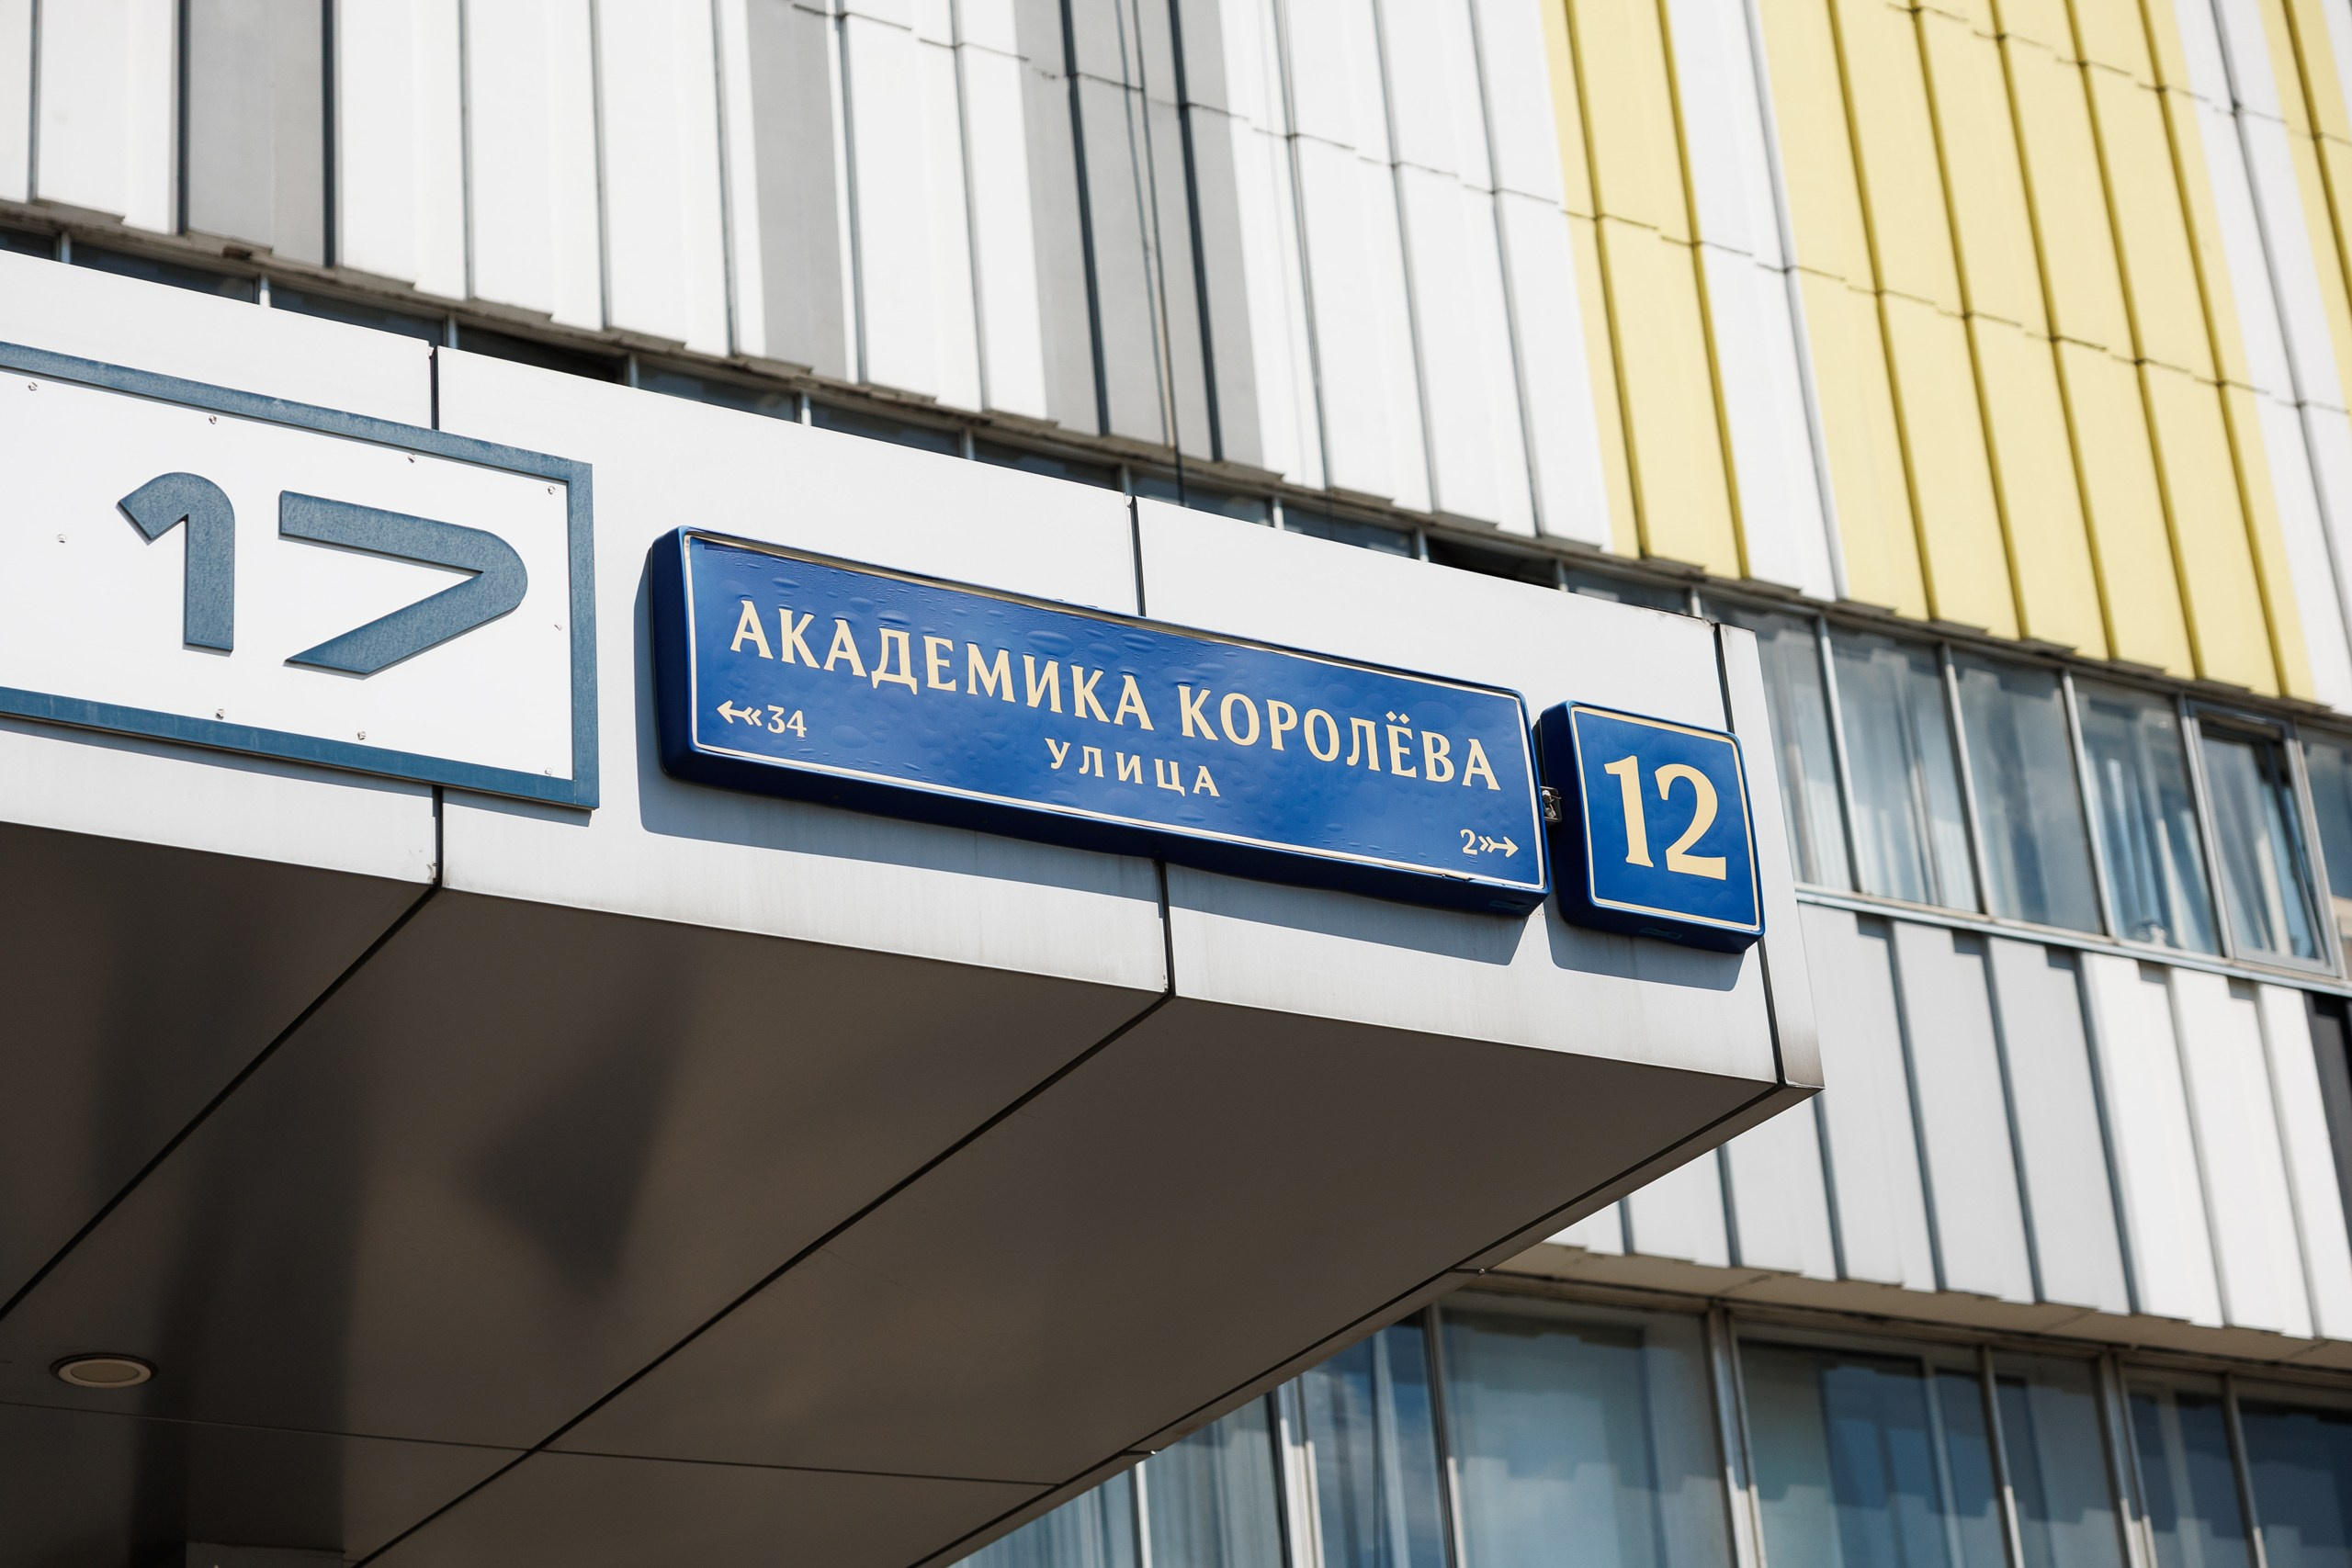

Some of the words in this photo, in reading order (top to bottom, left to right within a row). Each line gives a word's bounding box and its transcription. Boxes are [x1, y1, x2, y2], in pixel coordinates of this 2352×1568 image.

[117, 471, 528, 676] 17
[729, 599, 1155, 731] АКАДЕМИКА
[1177, 684, 1501, 791] КОРОЛЁВА
[767, 704, 808, 739] 34
[1044, 738, 1221, 797] УЛИЦА
[1459, 829, 1478, 856] 2
[1603, 755, 1726, 881] 12
